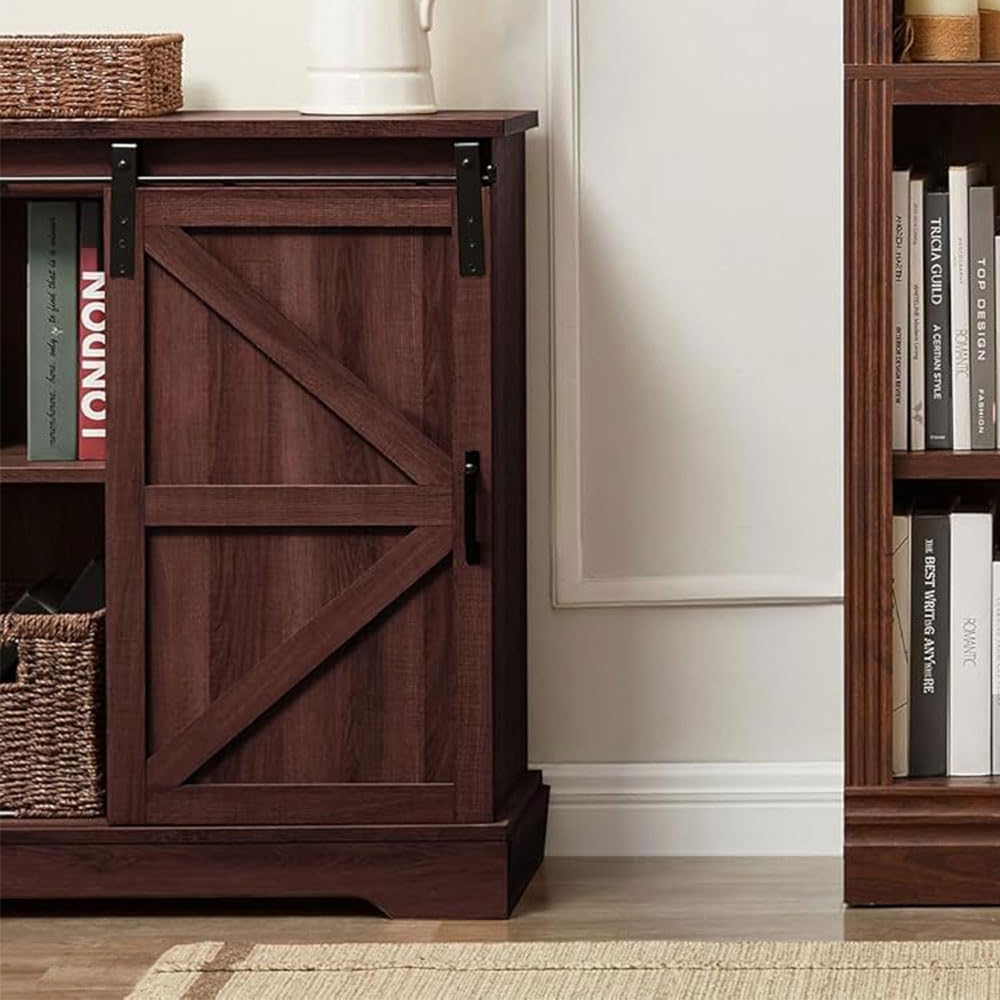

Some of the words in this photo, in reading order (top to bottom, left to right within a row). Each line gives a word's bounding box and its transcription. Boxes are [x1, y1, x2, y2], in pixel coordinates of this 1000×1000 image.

[930, 217, 943, 261] TRICIA
[931, 263, 943, 305] GUILD
[977, 258, 986, 290] TOP
[932, 324, 941, 332] A
[977, 299, 986, 361] DESIGN
[932, 333, 942, 370] CERTIAN
[955, 329, 968, 379] ROMANTIC
[933, 372, 942, 400] STYLE
[924, 556, 936, 587] BEST
[963, 618, 976, 667] ROMANTIC
